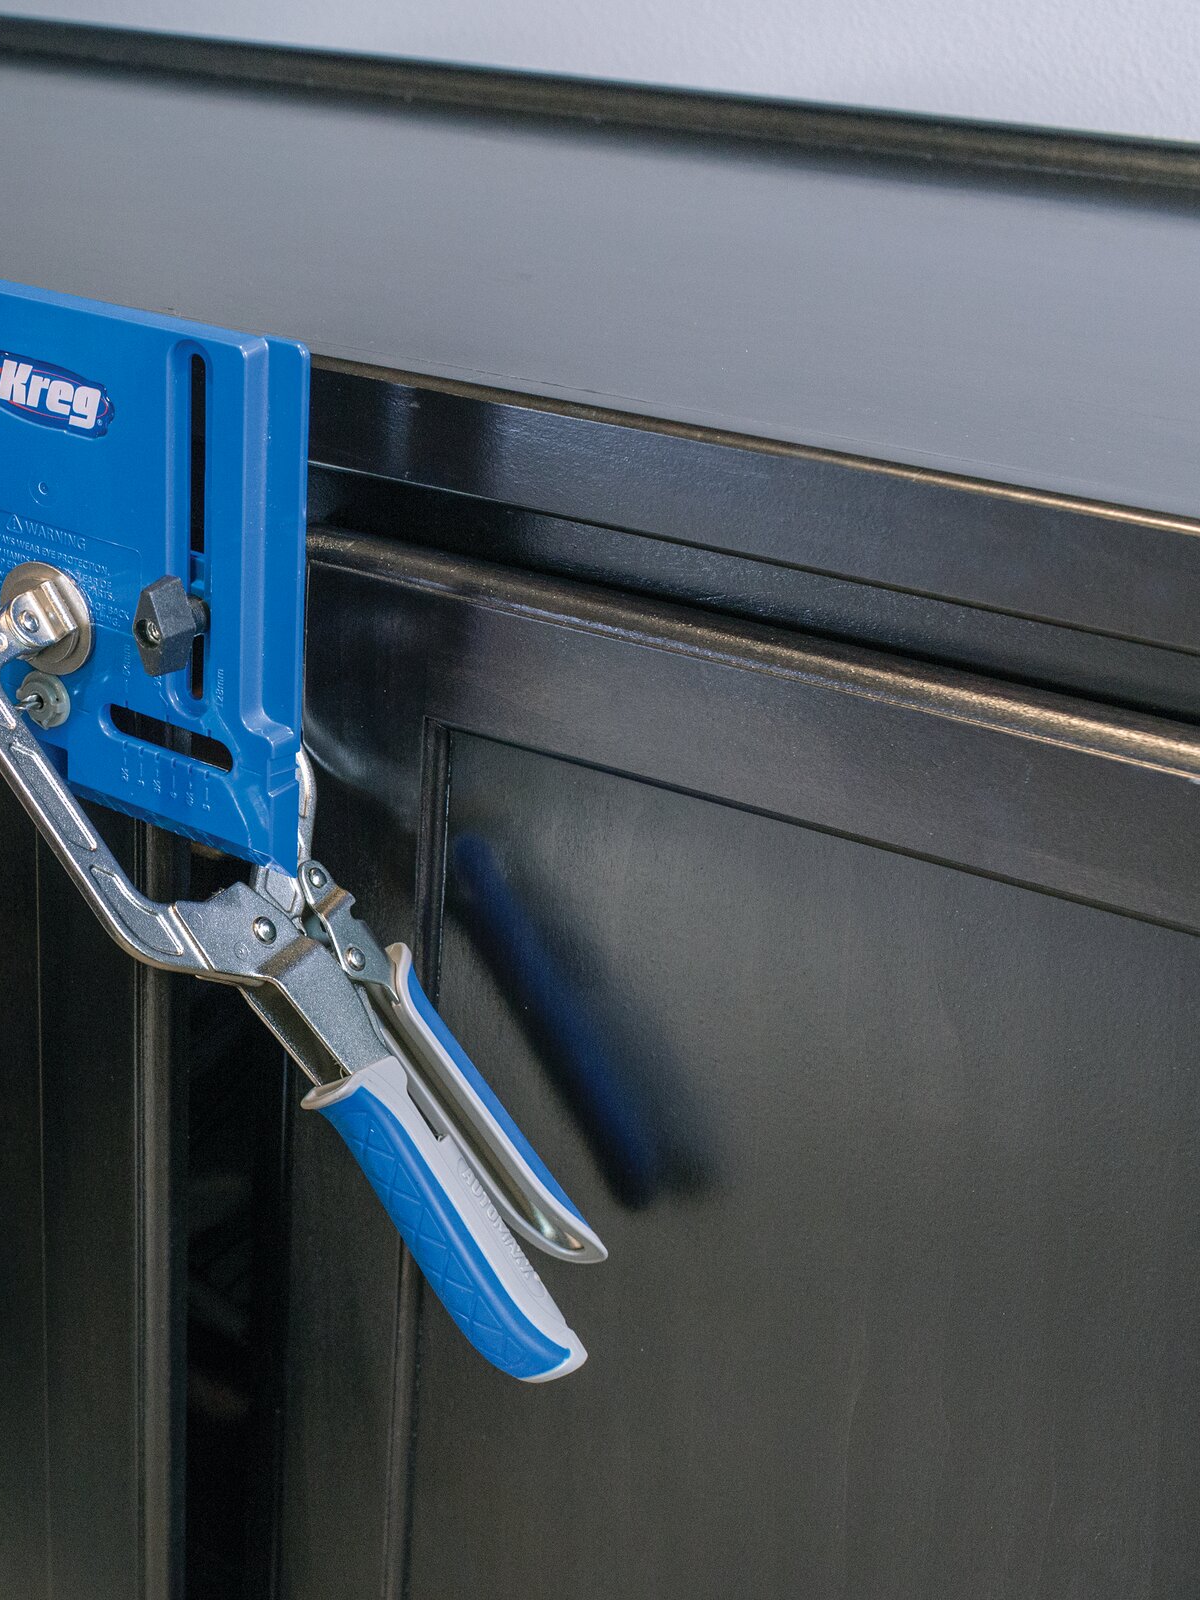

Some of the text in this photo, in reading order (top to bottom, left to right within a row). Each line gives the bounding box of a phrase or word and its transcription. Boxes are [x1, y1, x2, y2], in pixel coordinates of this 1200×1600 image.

[25, 520, 86, 551] WARNING
[16, 539, 40, 554] WEAR
[41, 546, 56, 558] EYE
[57, 552, 110, 577] PROTECTION.
[107, 605, 130, 621] BACK
